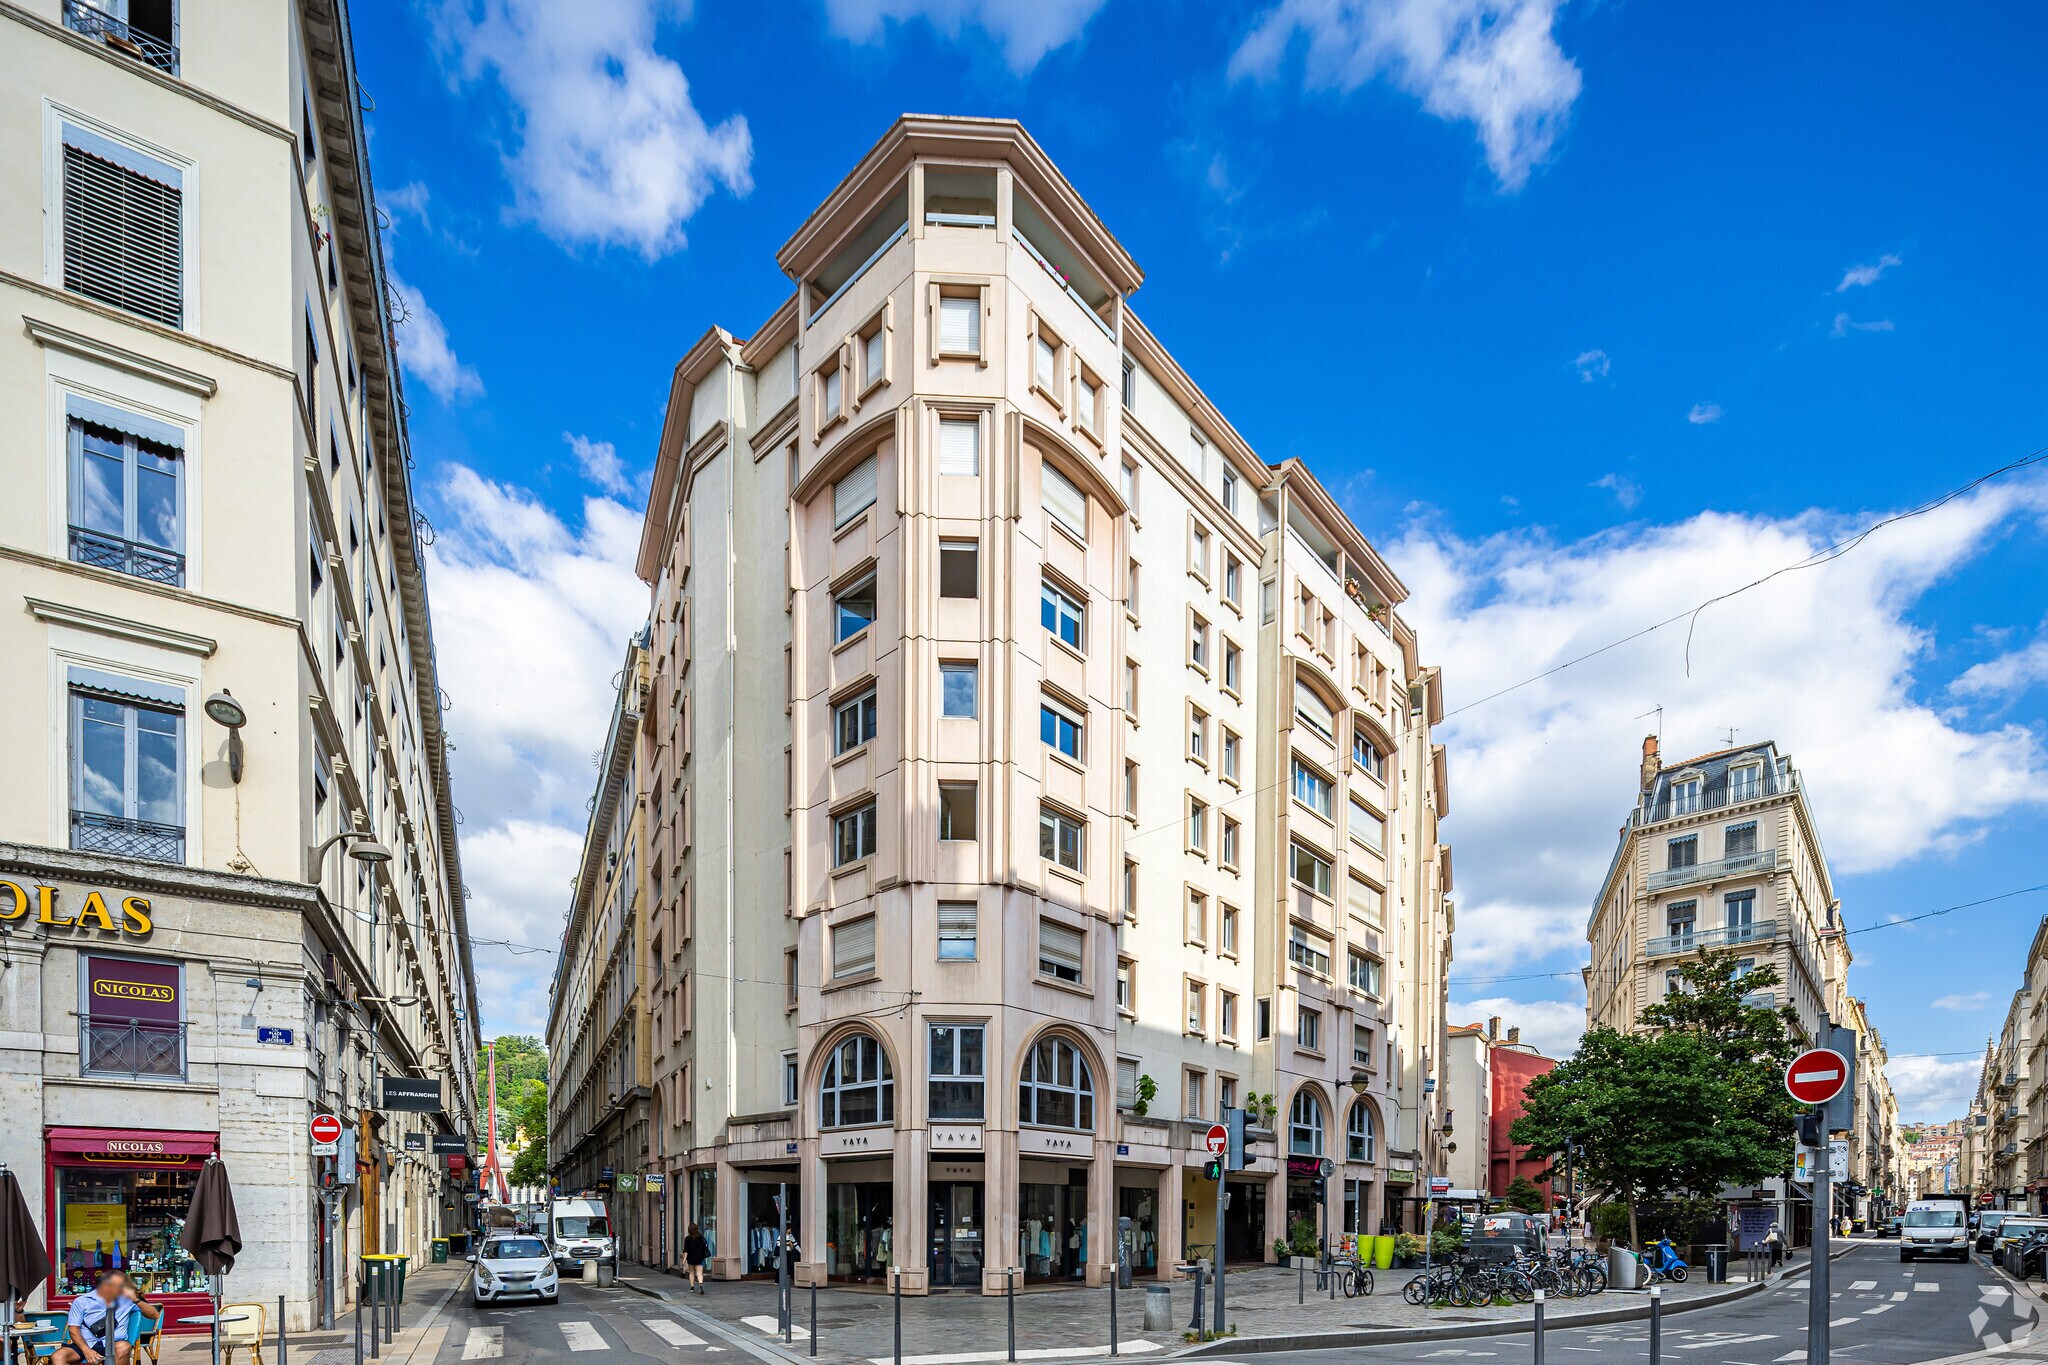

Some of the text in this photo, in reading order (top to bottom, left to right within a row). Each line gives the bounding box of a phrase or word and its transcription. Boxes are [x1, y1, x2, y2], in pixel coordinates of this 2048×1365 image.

[99, 982, 170, 999] NICOLAS
[842, 1137, 868, 1146] YAYA
[936, 1133, 977, 1141] YAYA
[109, 1142, 162, 1152] NICOLAS
[1046, 1138, 1072, 1148] YAYA
